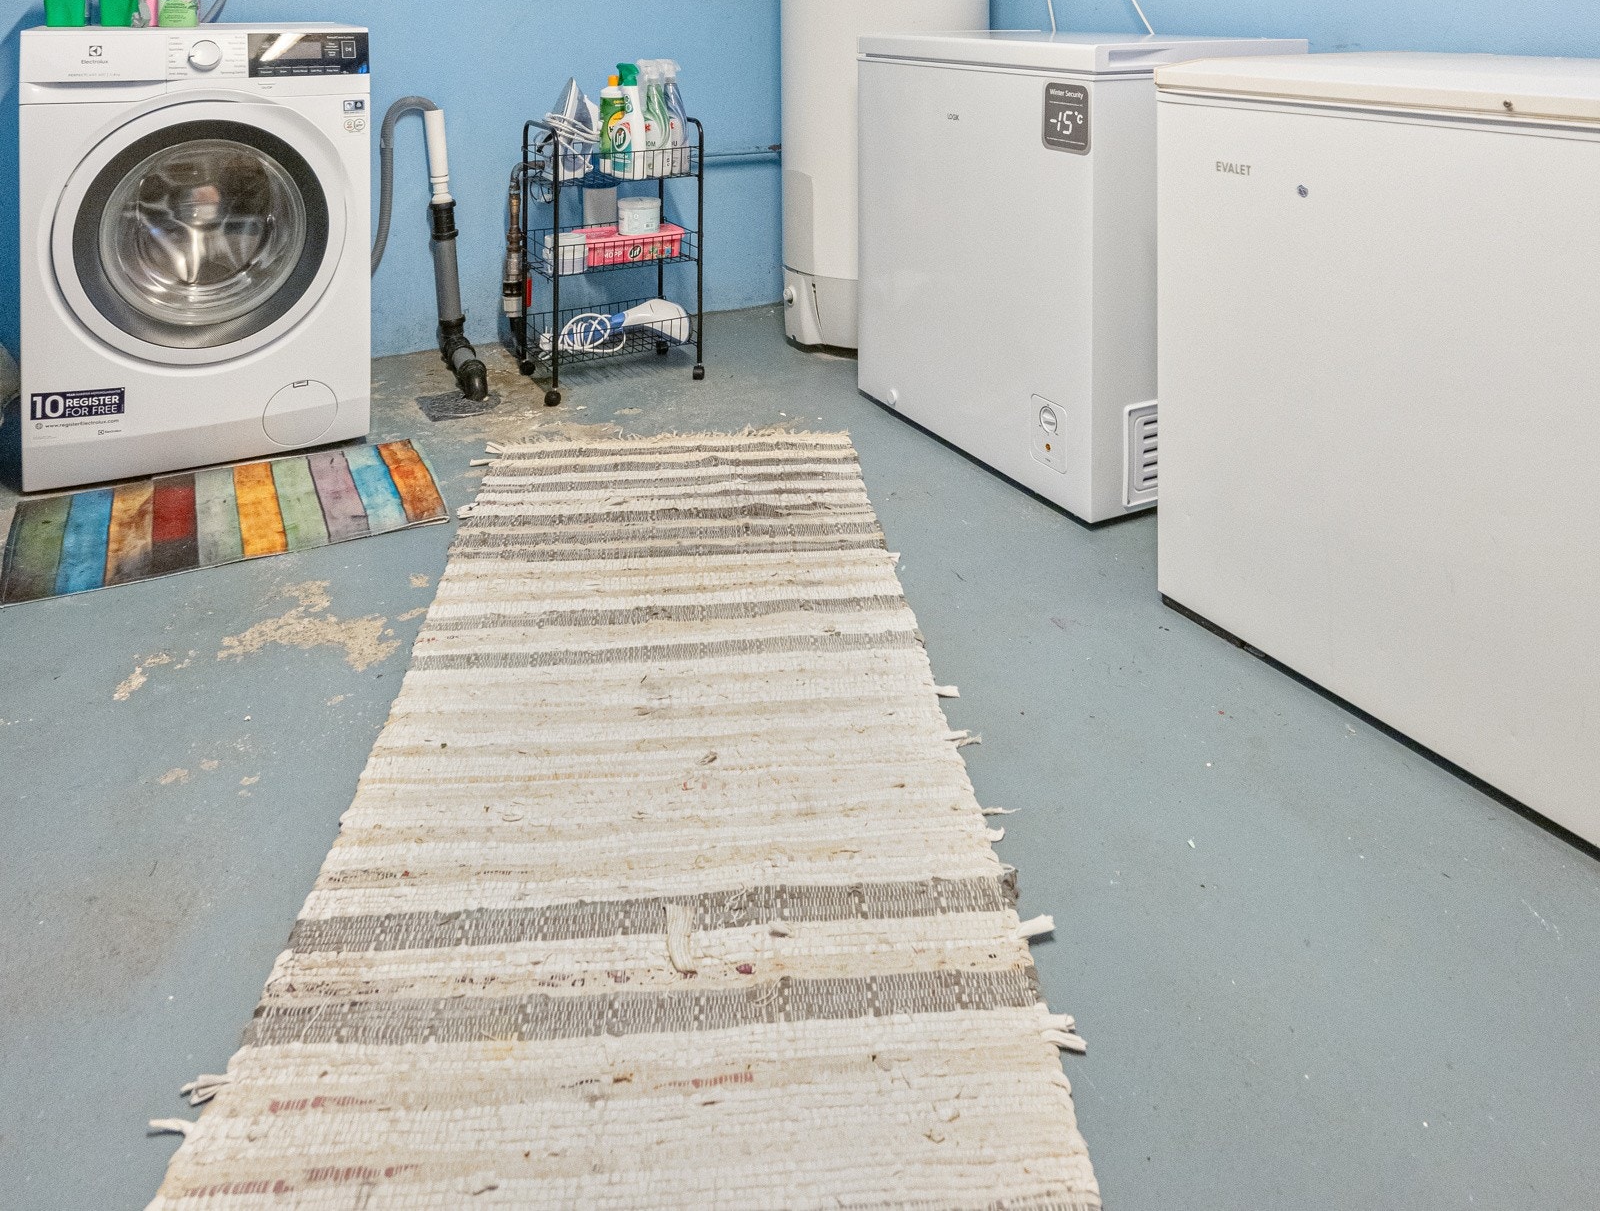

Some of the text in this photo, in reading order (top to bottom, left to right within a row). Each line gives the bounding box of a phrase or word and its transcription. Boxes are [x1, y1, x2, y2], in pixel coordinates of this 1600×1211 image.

[1216, 161, 1251, 176] EVALET
[32, 394, 65, 419] 10
[65, 395, 119, 408] REGISTER
[65, 404, 118, 417] FOR FREE
